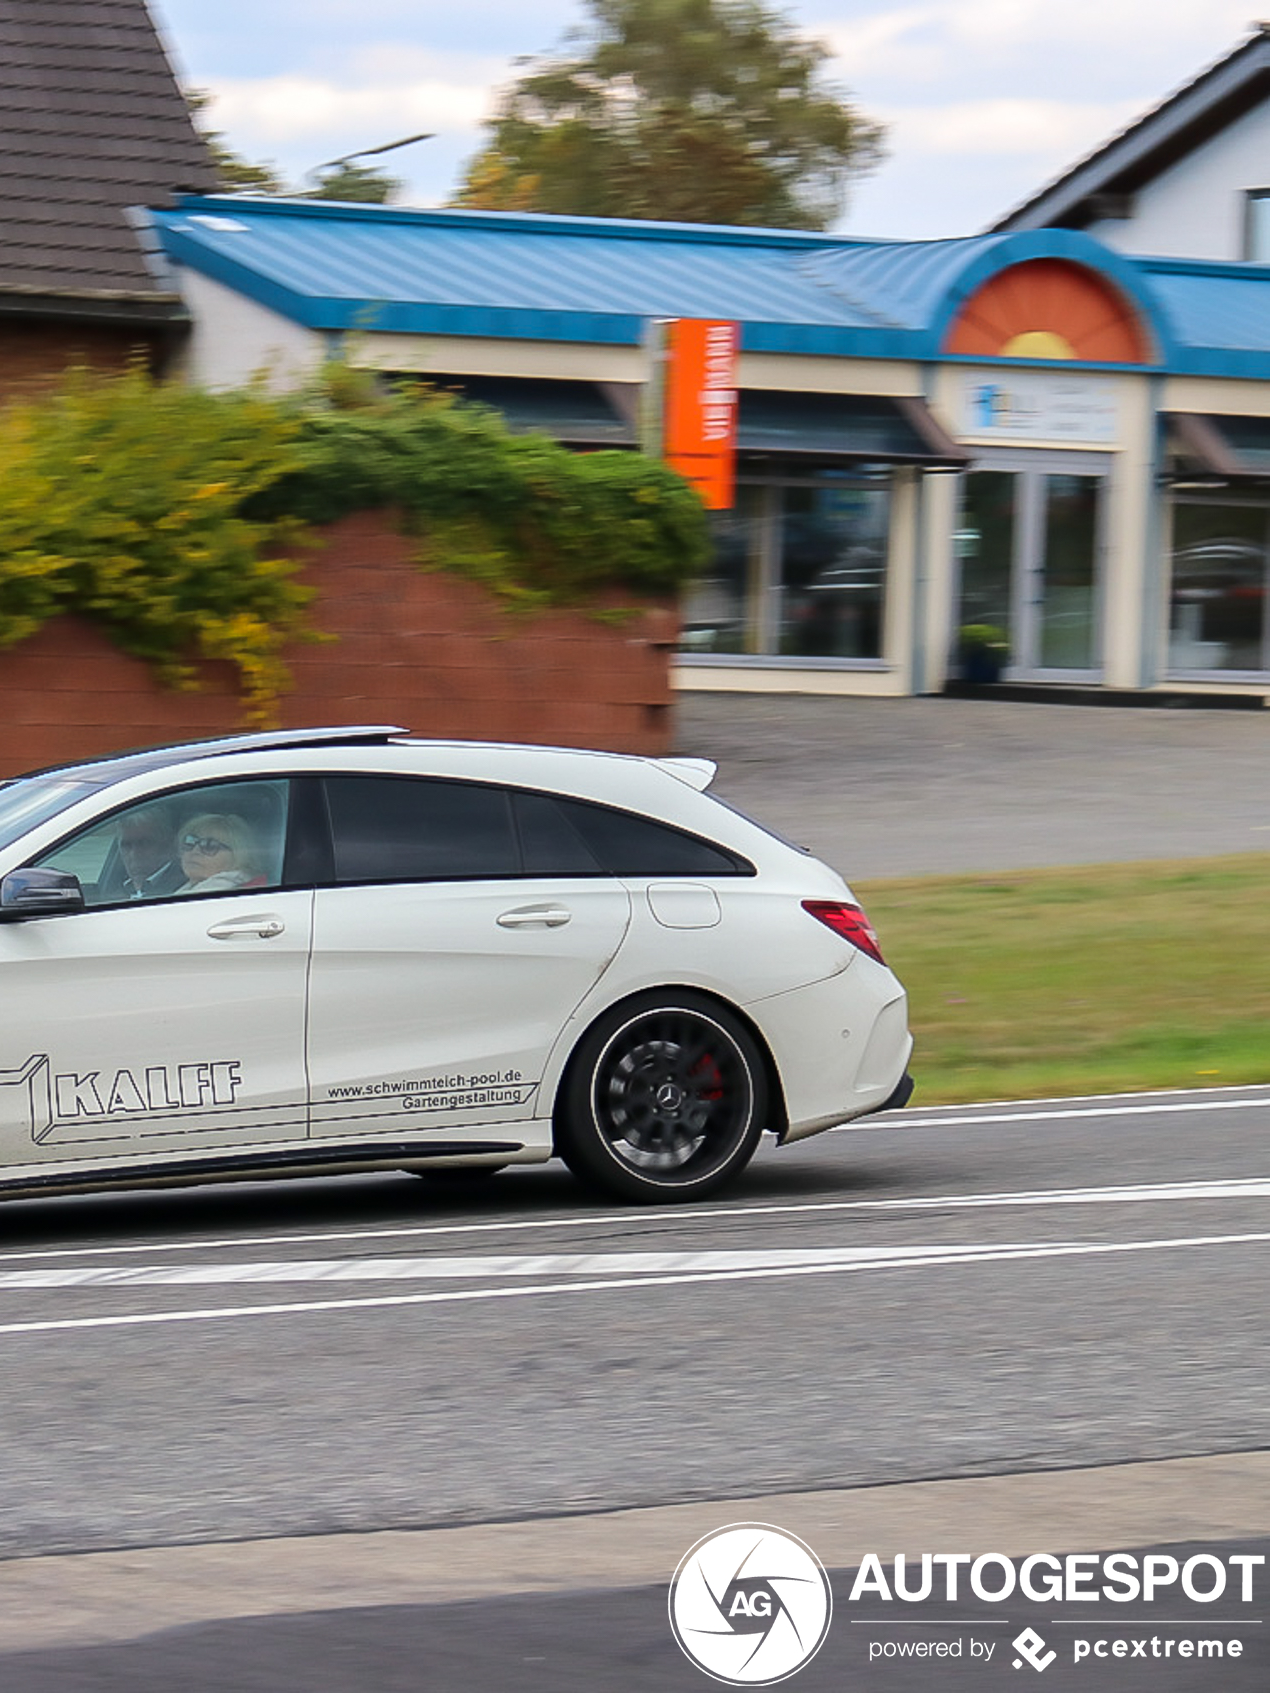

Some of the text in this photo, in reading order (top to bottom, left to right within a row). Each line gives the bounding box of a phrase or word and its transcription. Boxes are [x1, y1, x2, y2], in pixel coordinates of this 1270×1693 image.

[55, 1061, 242, 1117] KALFF
[328, 1070, 522, 1097] www.schwimmteich-pool.de
[402, 1088, 521, 1110] Gartengestaltung
